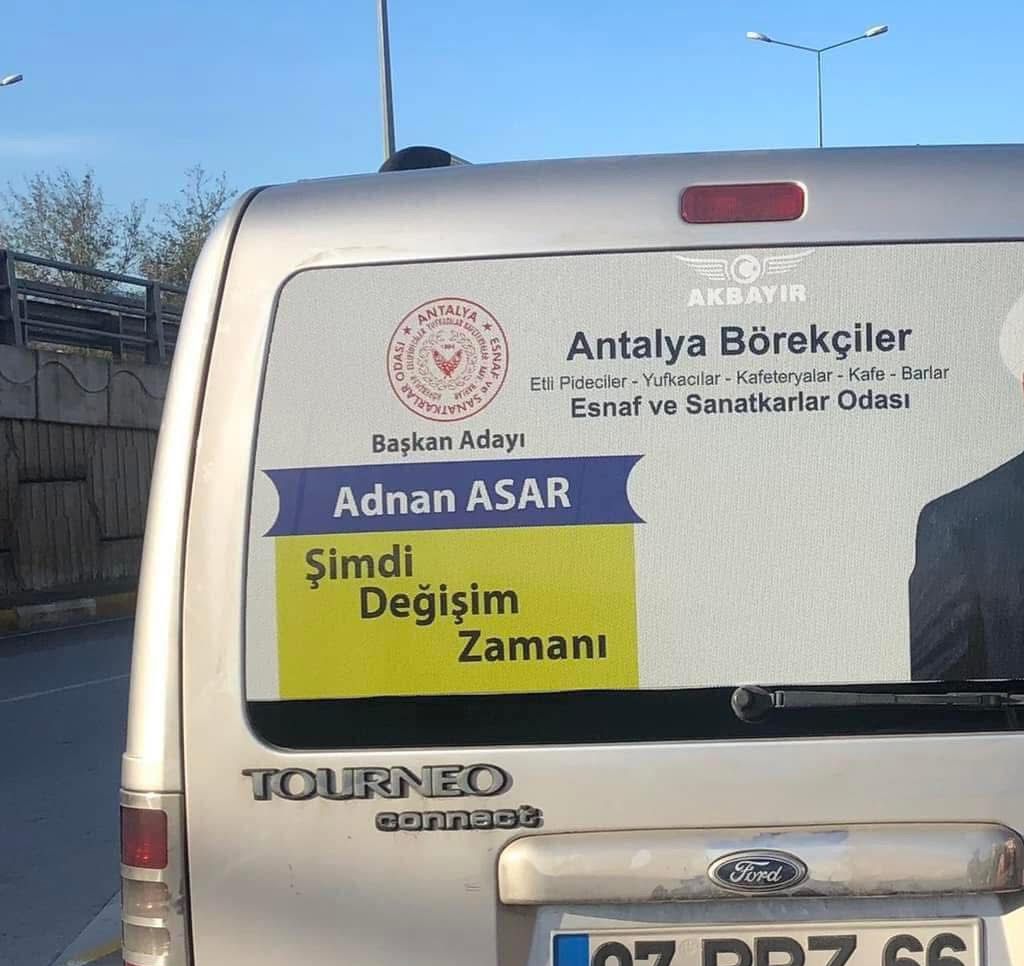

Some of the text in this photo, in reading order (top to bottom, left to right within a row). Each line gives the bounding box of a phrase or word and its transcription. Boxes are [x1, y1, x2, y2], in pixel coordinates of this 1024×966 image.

[687, 283, 807, 307] AKBAYIR
[417, 304, 478, 326] ANTALYA
[393, 341, 405, 381] ODASI
[490, 337, 502, 379] ESNAF
[566, 323, 913, 366] Antalya Börekçiler
[530, 375, 555, 392] Etli
[560, 373, 627, 391] Pideciler
[643, 370, 721, 389] Yufkacılar
[736, 367, 833, 387] Kafeteryalar
[849, 367, 885, 382] Kafe
[902, 366, 949, 381] Barlar
[571, 389, 911, 418] Esnaf ve Sanatkarlar Odası
[371, 430, 525, 456] Başkan Adayı
[333, 477, 572, 518] Adnan ASAR
[305, 544, 414, 589] Şimdi
[360, 583, 519, 626] Değişim
[458, 630, 607, 664] Zamanı
[242, 763, 513, 800] TOURNEO
[375, 805, 544, 832] connect
[729, 860, 783, 883] Ford
